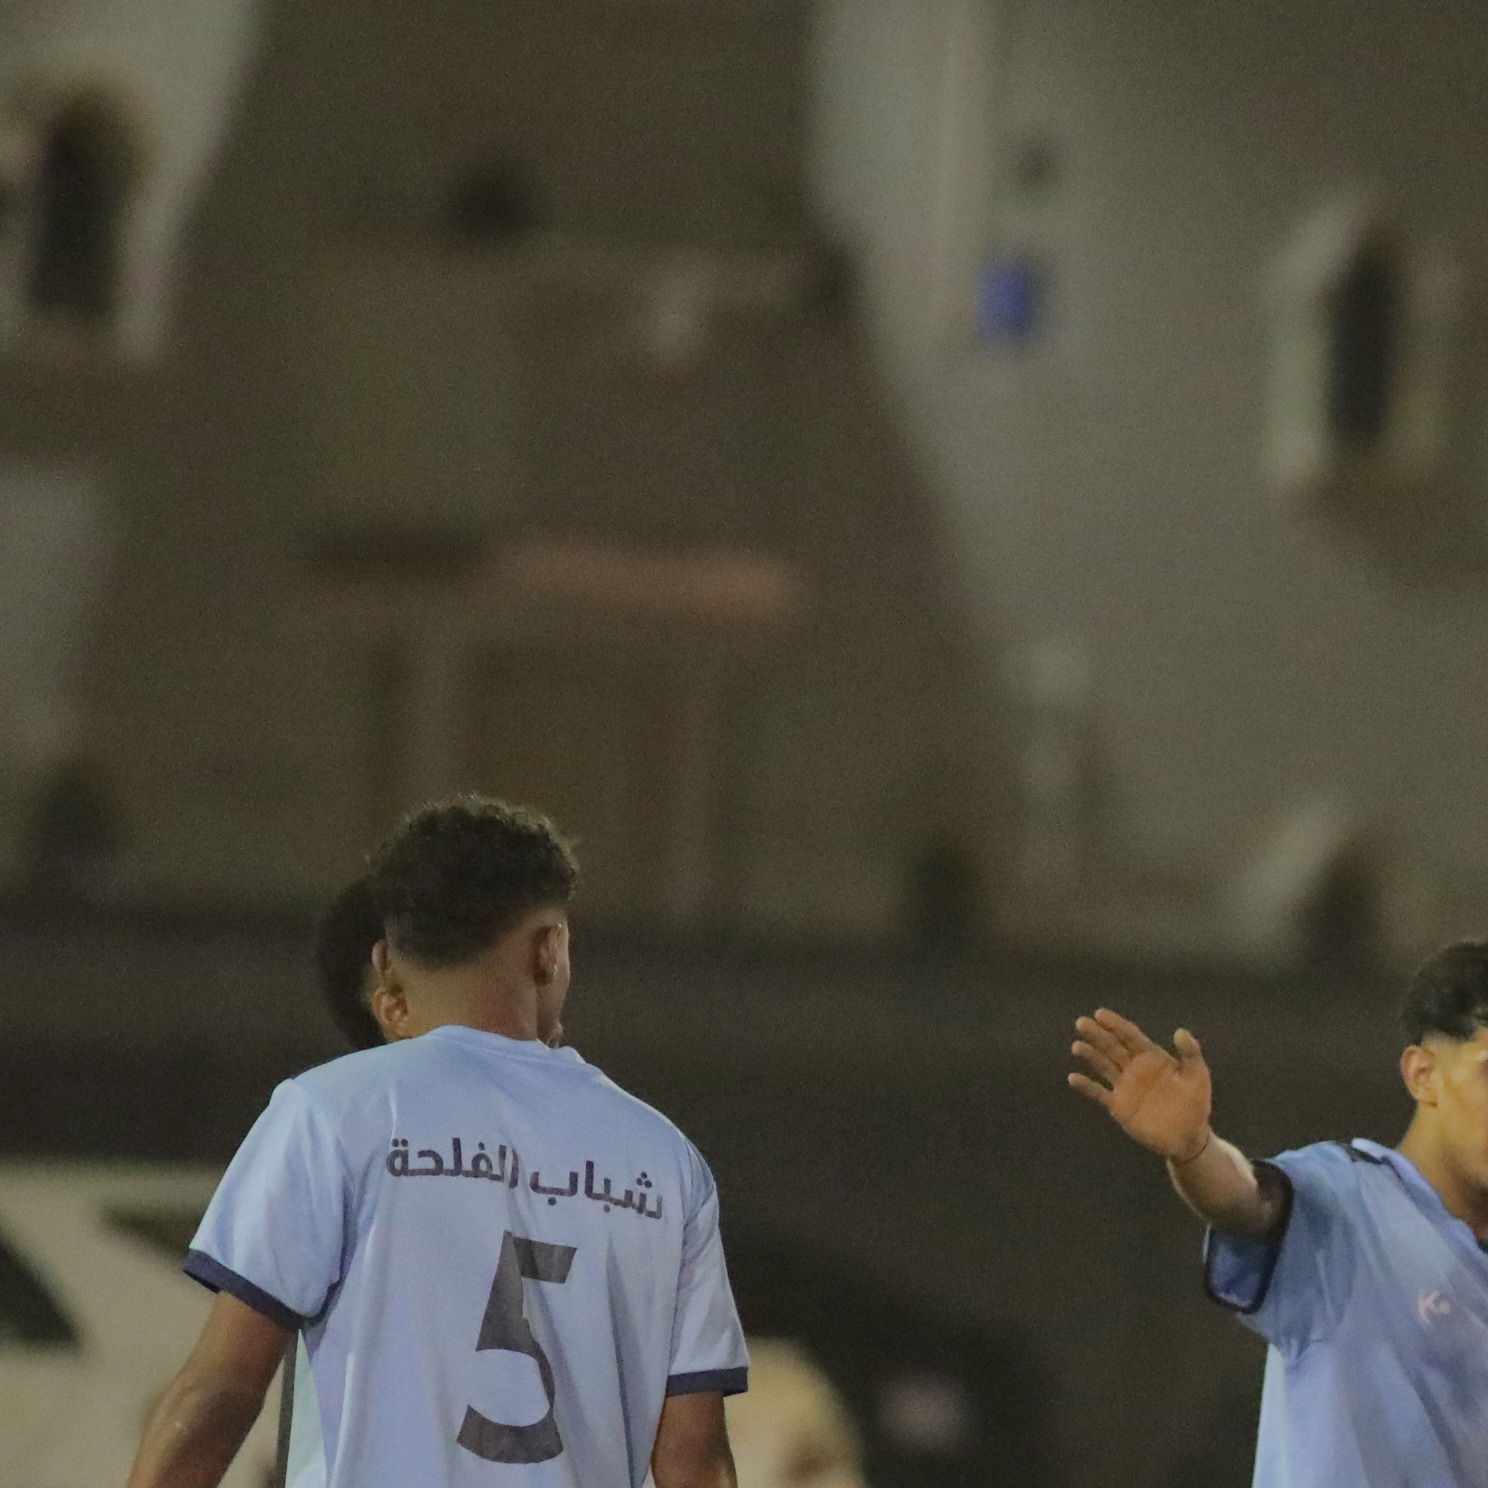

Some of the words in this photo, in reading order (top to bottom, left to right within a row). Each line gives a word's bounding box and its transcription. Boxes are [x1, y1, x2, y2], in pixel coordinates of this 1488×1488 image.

[385, 1136, 520, 1190] الفلحة
[529, 1160, 664, 1221] شباب
[456, 1230, 578, 1464] 5
